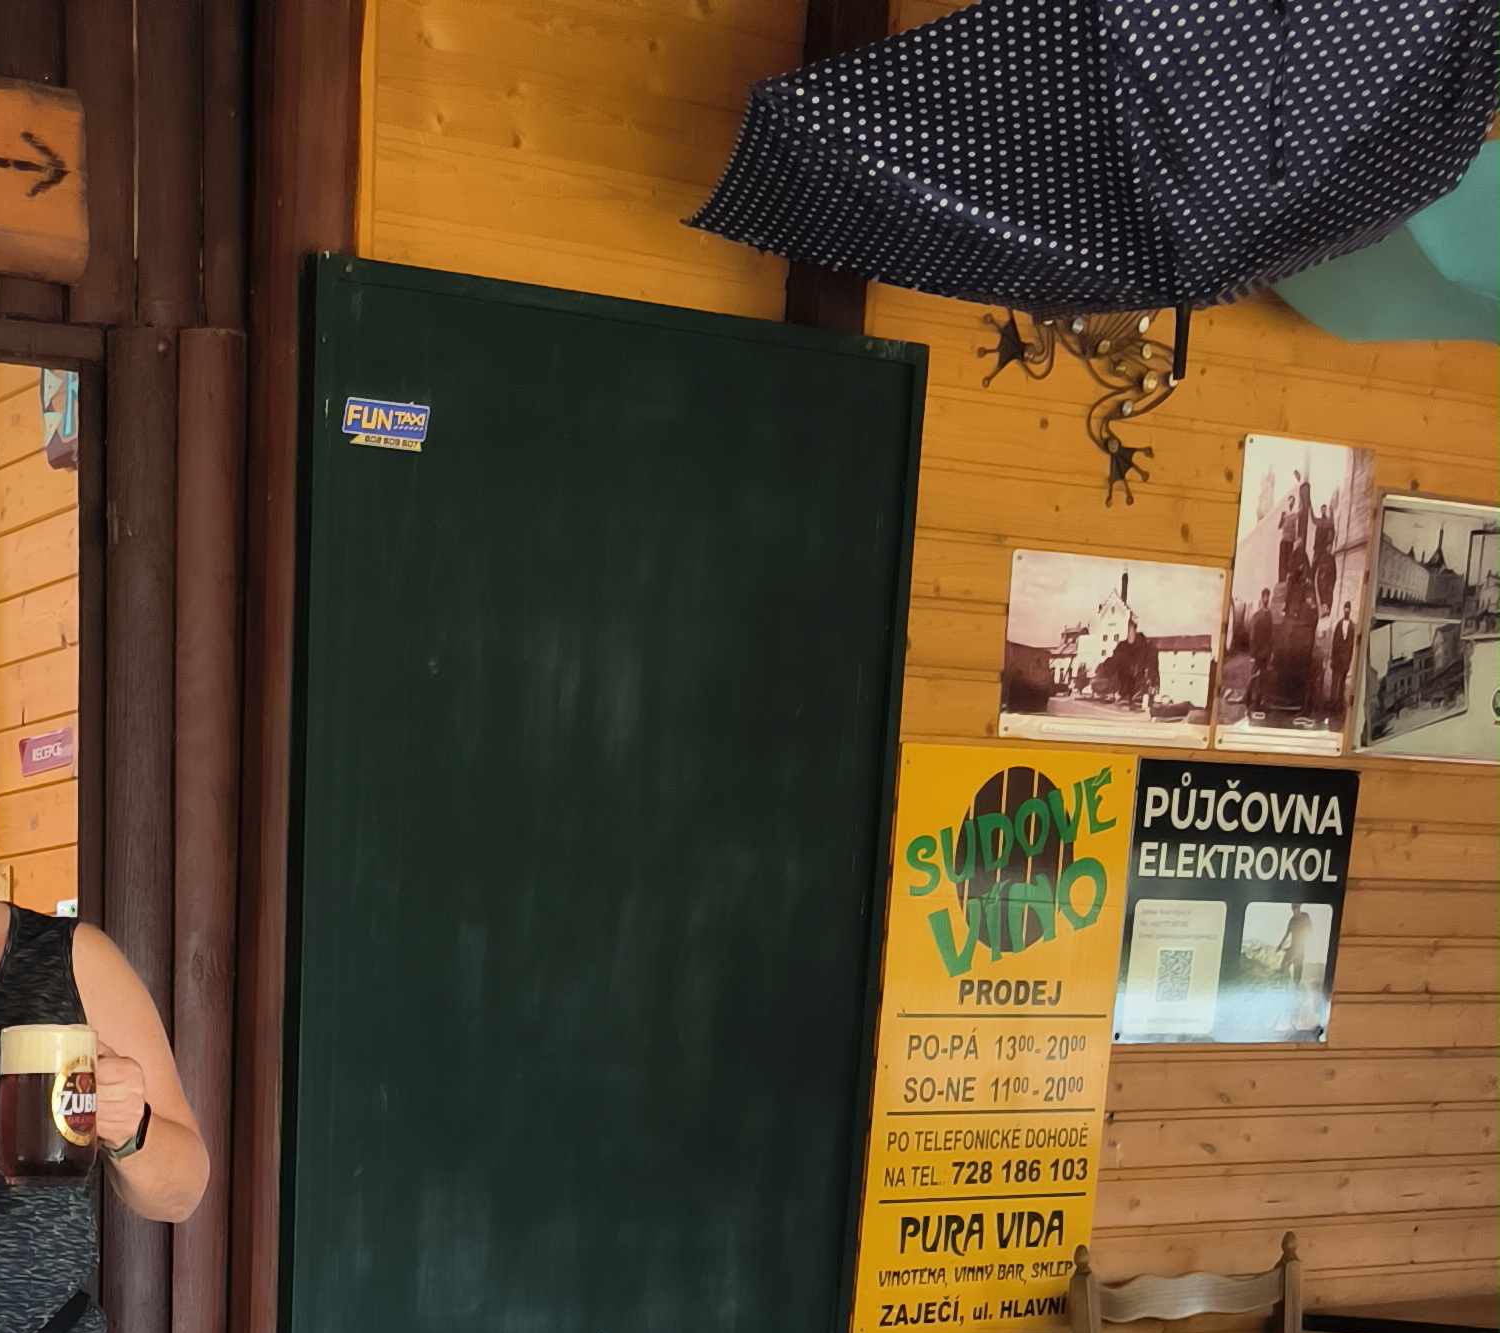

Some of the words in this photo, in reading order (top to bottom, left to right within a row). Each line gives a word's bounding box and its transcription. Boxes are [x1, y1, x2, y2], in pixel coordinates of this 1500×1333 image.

[347, 405, 393, 431] FUN
[394, 411, 427, 427] TAXI
[1143, 771, 1344, 836] PŮJČOVNA
[905, 765, 1117, 897] SUDOVÉ
[1137, 841, 1338, 883] ELEKTROKOL
[926, 856, 1108, 979] VÍNO
[958, 979, 1063, 1006] PRODEJ
[907, 1028, 979, 1061] PO-PÁ
[903, 1076, 977, 1104] SO-NE
[886, 1131, 910, 1152] PO
[914, 1123, 1021, 1151] TELEFONICKÉ
[1024, 1121, 1089, 1149] DOHODĚ
[883, 1167, 906, 1188] NA
[951, 1160, 993, 1185] 728
[1000, 1159, 1041, 1184] 186
[1049, 1157, 1088, 1181] 103
[899, 1213, 985, 1257] PURA
[996, 1209, 1065, 1249] VIDA
[1030, 1260, 1073, 1279] SKLEP
[878, 1295, 965, 1327] ZAJEČÍ,
[972, 1301, 994, 1321] ul.
